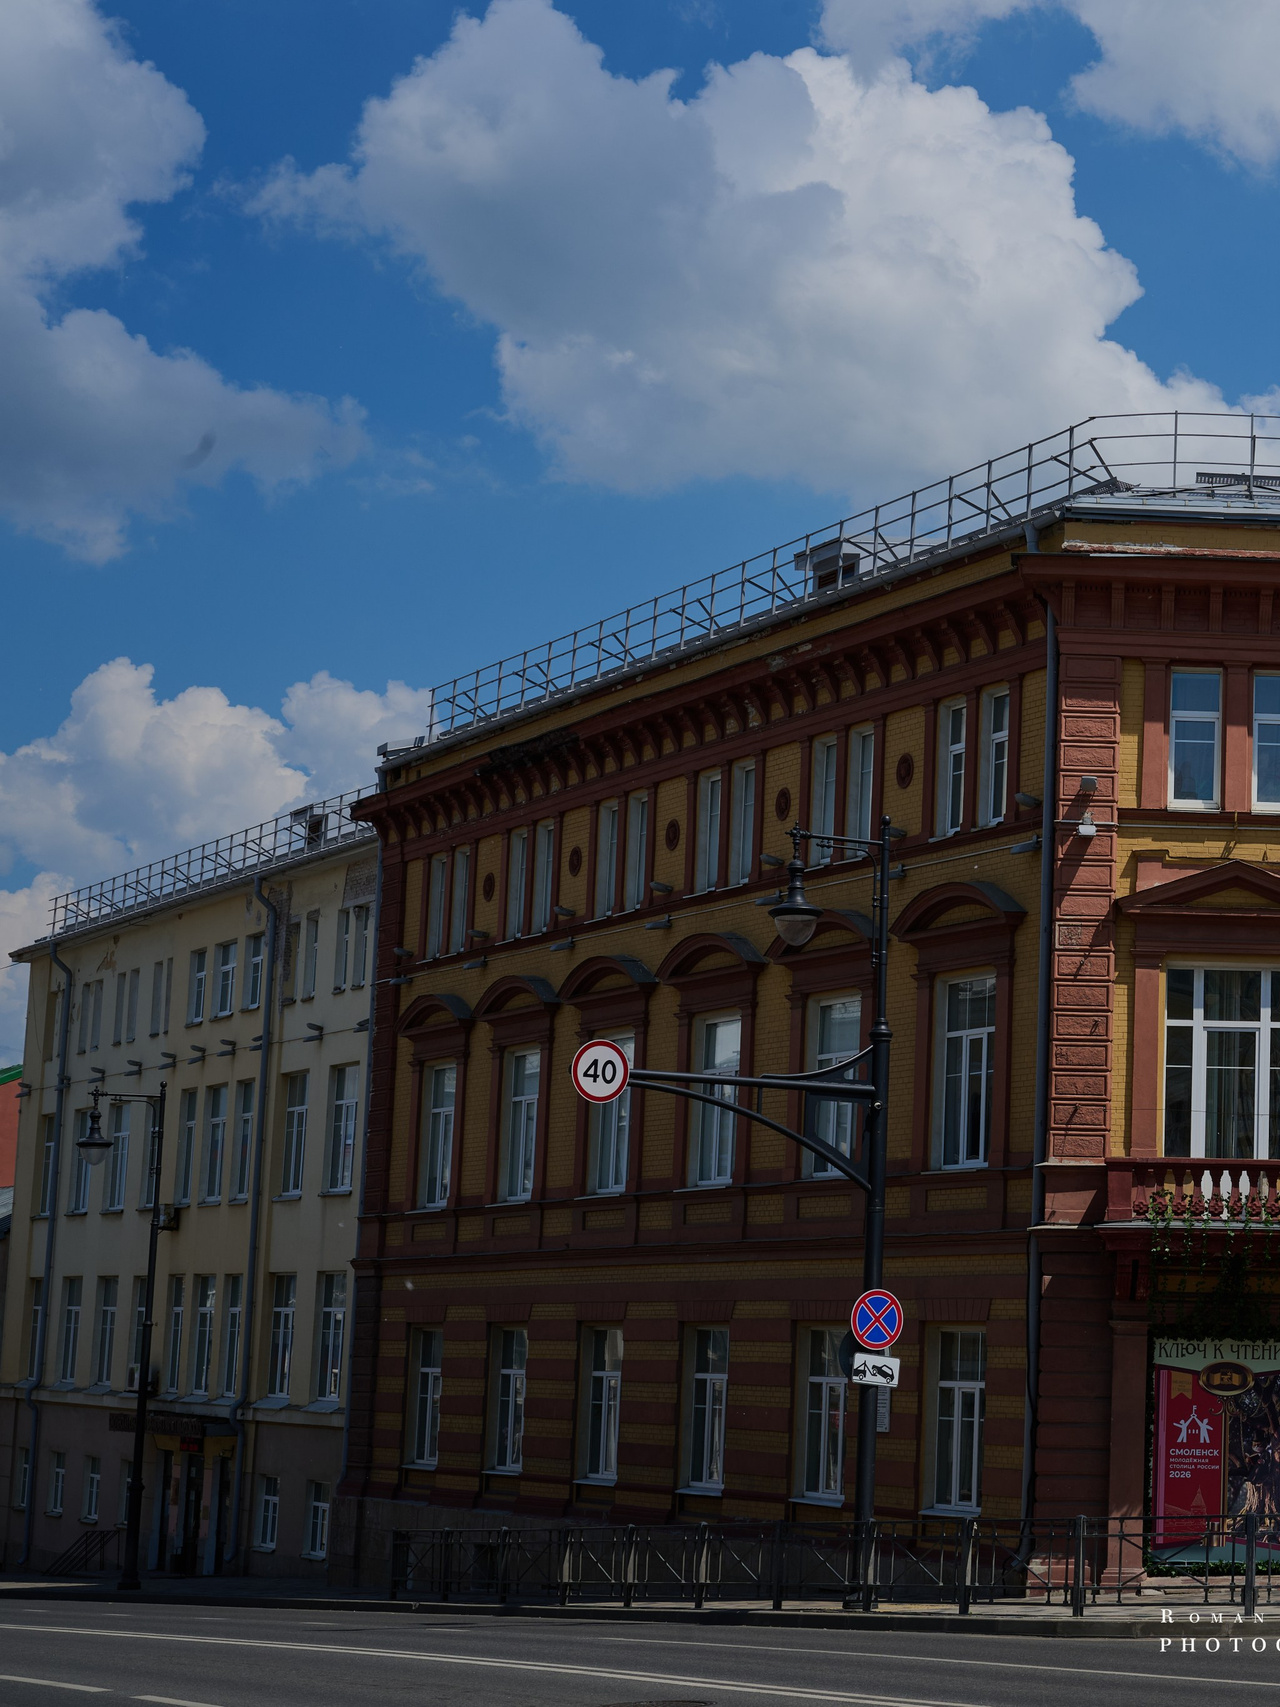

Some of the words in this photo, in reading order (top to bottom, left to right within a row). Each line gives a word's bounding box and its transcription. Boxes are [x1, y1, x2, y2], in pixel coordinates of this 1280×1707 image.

[583, 1059, 616, 1084] 40
[1158, 1342, 1207, 1359] КЛЮЧ
[1214, 1344, 1225, 1359] К
[1169, 1448, 1220, 1457] СМОЛЕНСК
[1169, 1470, 1191, 1478] 2026
